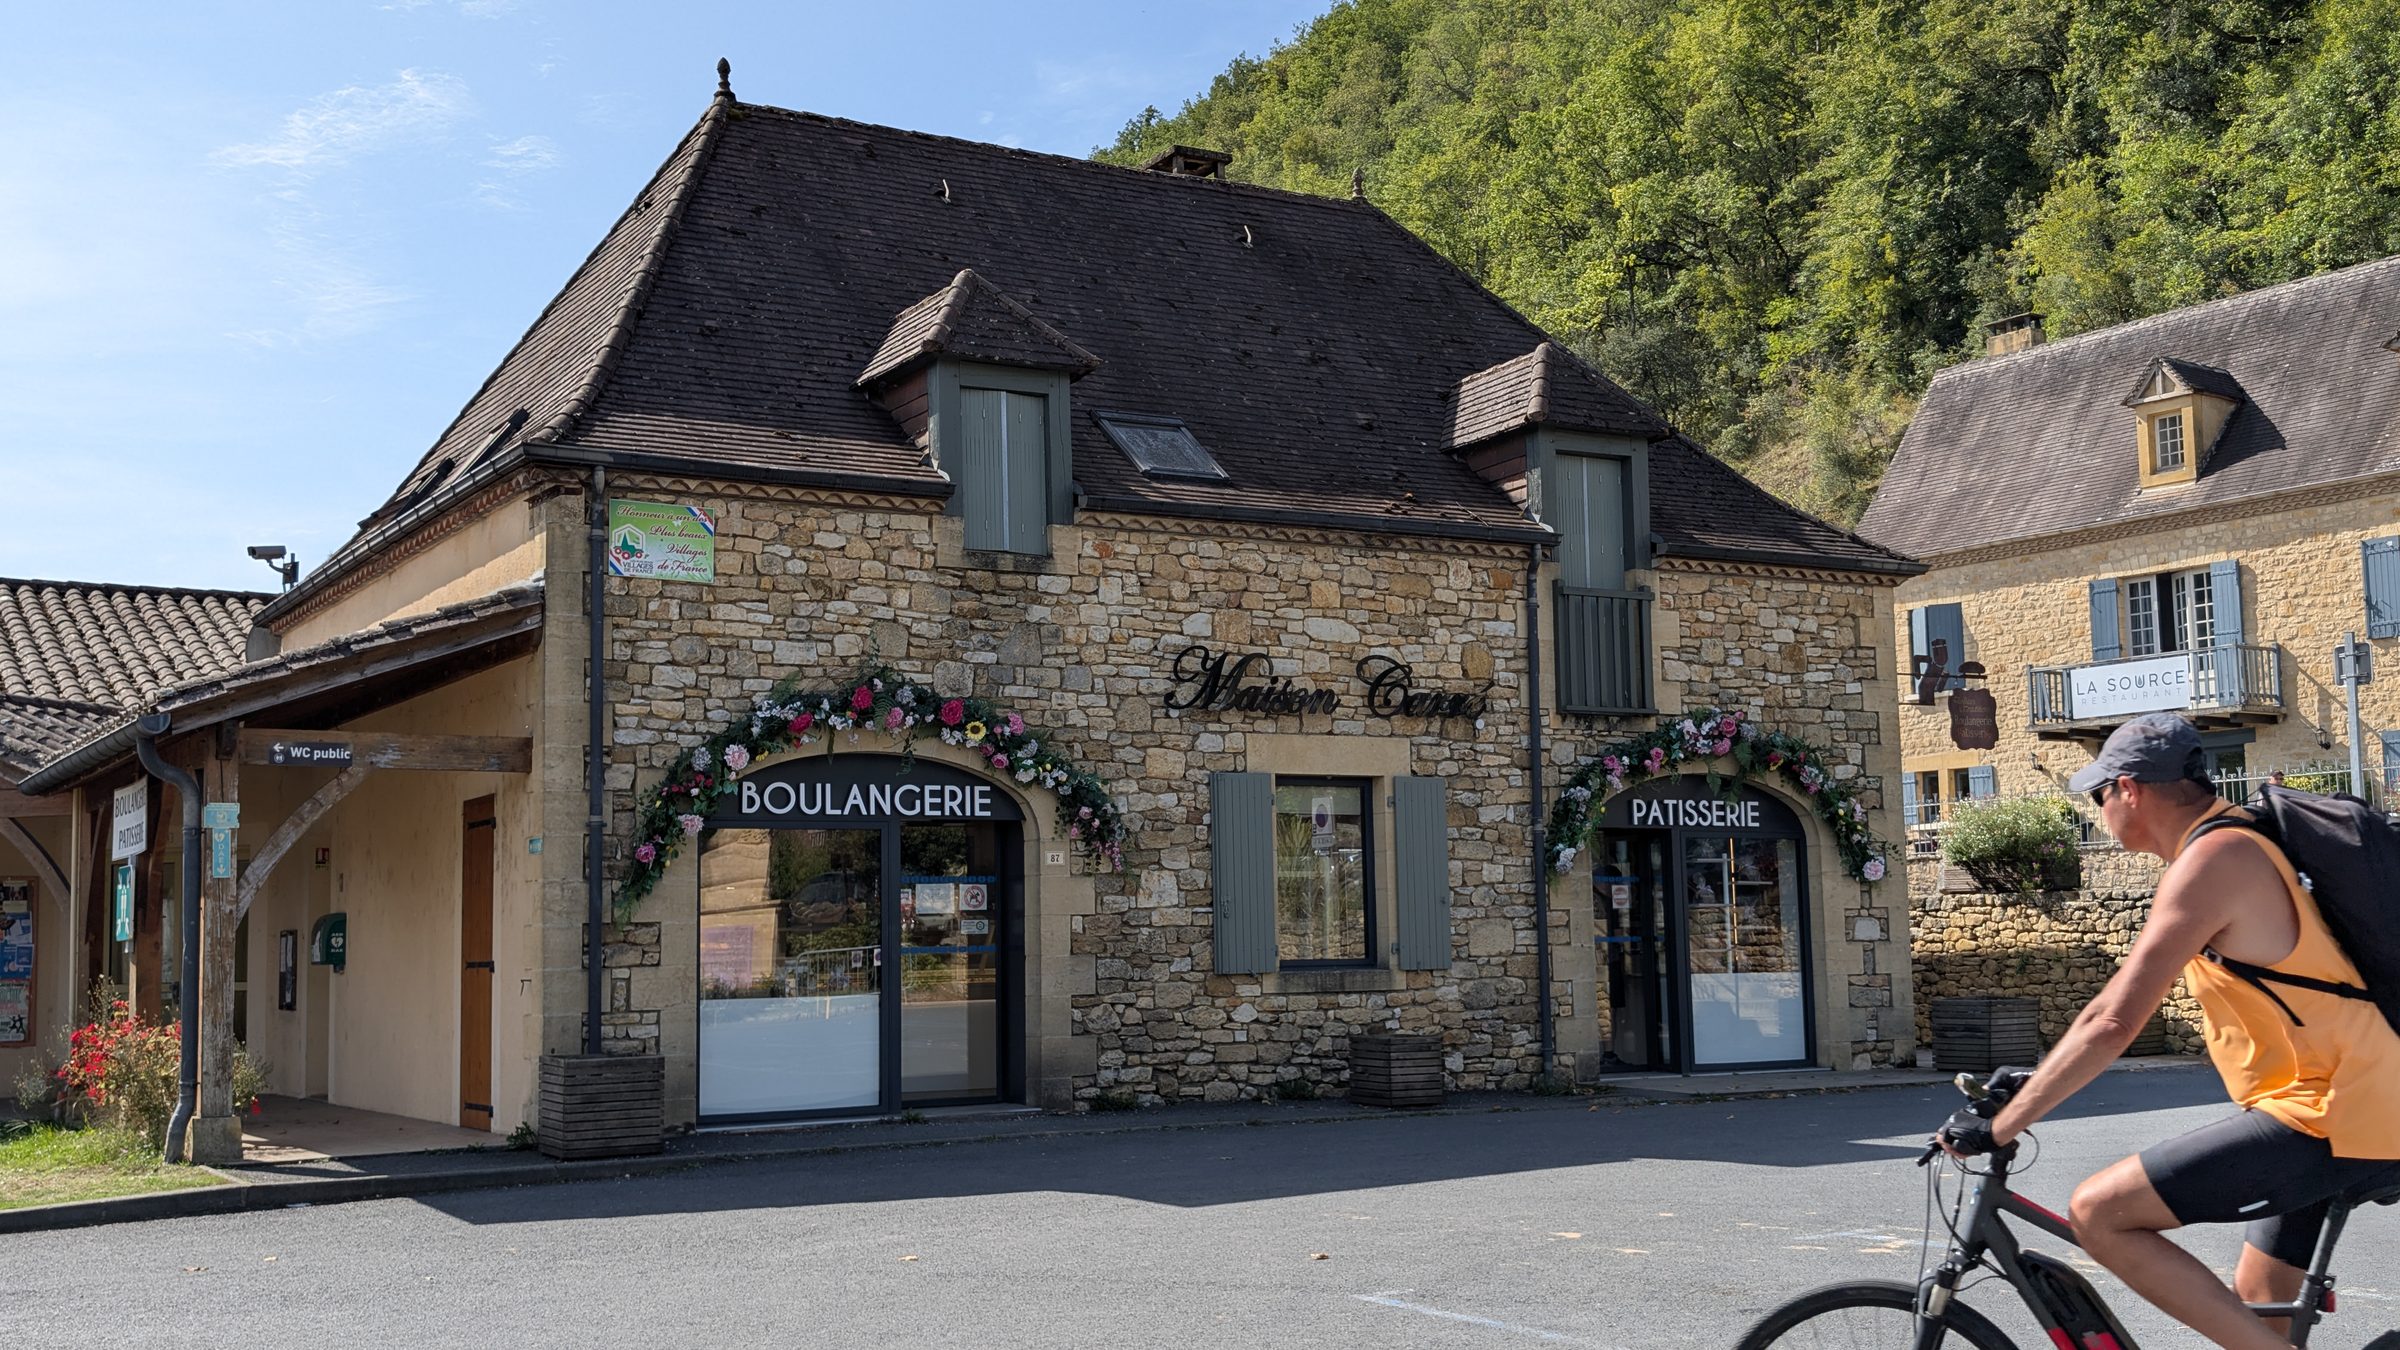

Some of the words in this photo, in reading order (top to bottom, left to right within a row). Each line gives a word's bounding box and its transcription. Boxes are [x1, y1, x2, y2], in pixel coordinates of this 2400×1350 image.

[617, 504, 665, 519] Honneur
[692, 511, 708, 523] des
[649, 525, 675, 538] Plus
[678, 525, 708, 539] beaux
[666, 543, 707, 563] Villages
[622, 561, 653, 569] VILLAGES
[657, 560, 669, 570] de
[671, 560, 708, 573] France
[1164, 645, 1341, 714] Maison
[2076, 681, 2097, 695] LA
[2107, 670, 2185, 692] SOURCE
[2081, 687, 2182, 705] RESTAURANT
[290, 746, 311, 758] WC
[313, 748, 351, 761] public
[741, 781, 992, 817] BOULANGERIE
[1632, 798, 1760, 827] PATISSERIE
[1050, 854, 1060, 863] 87
